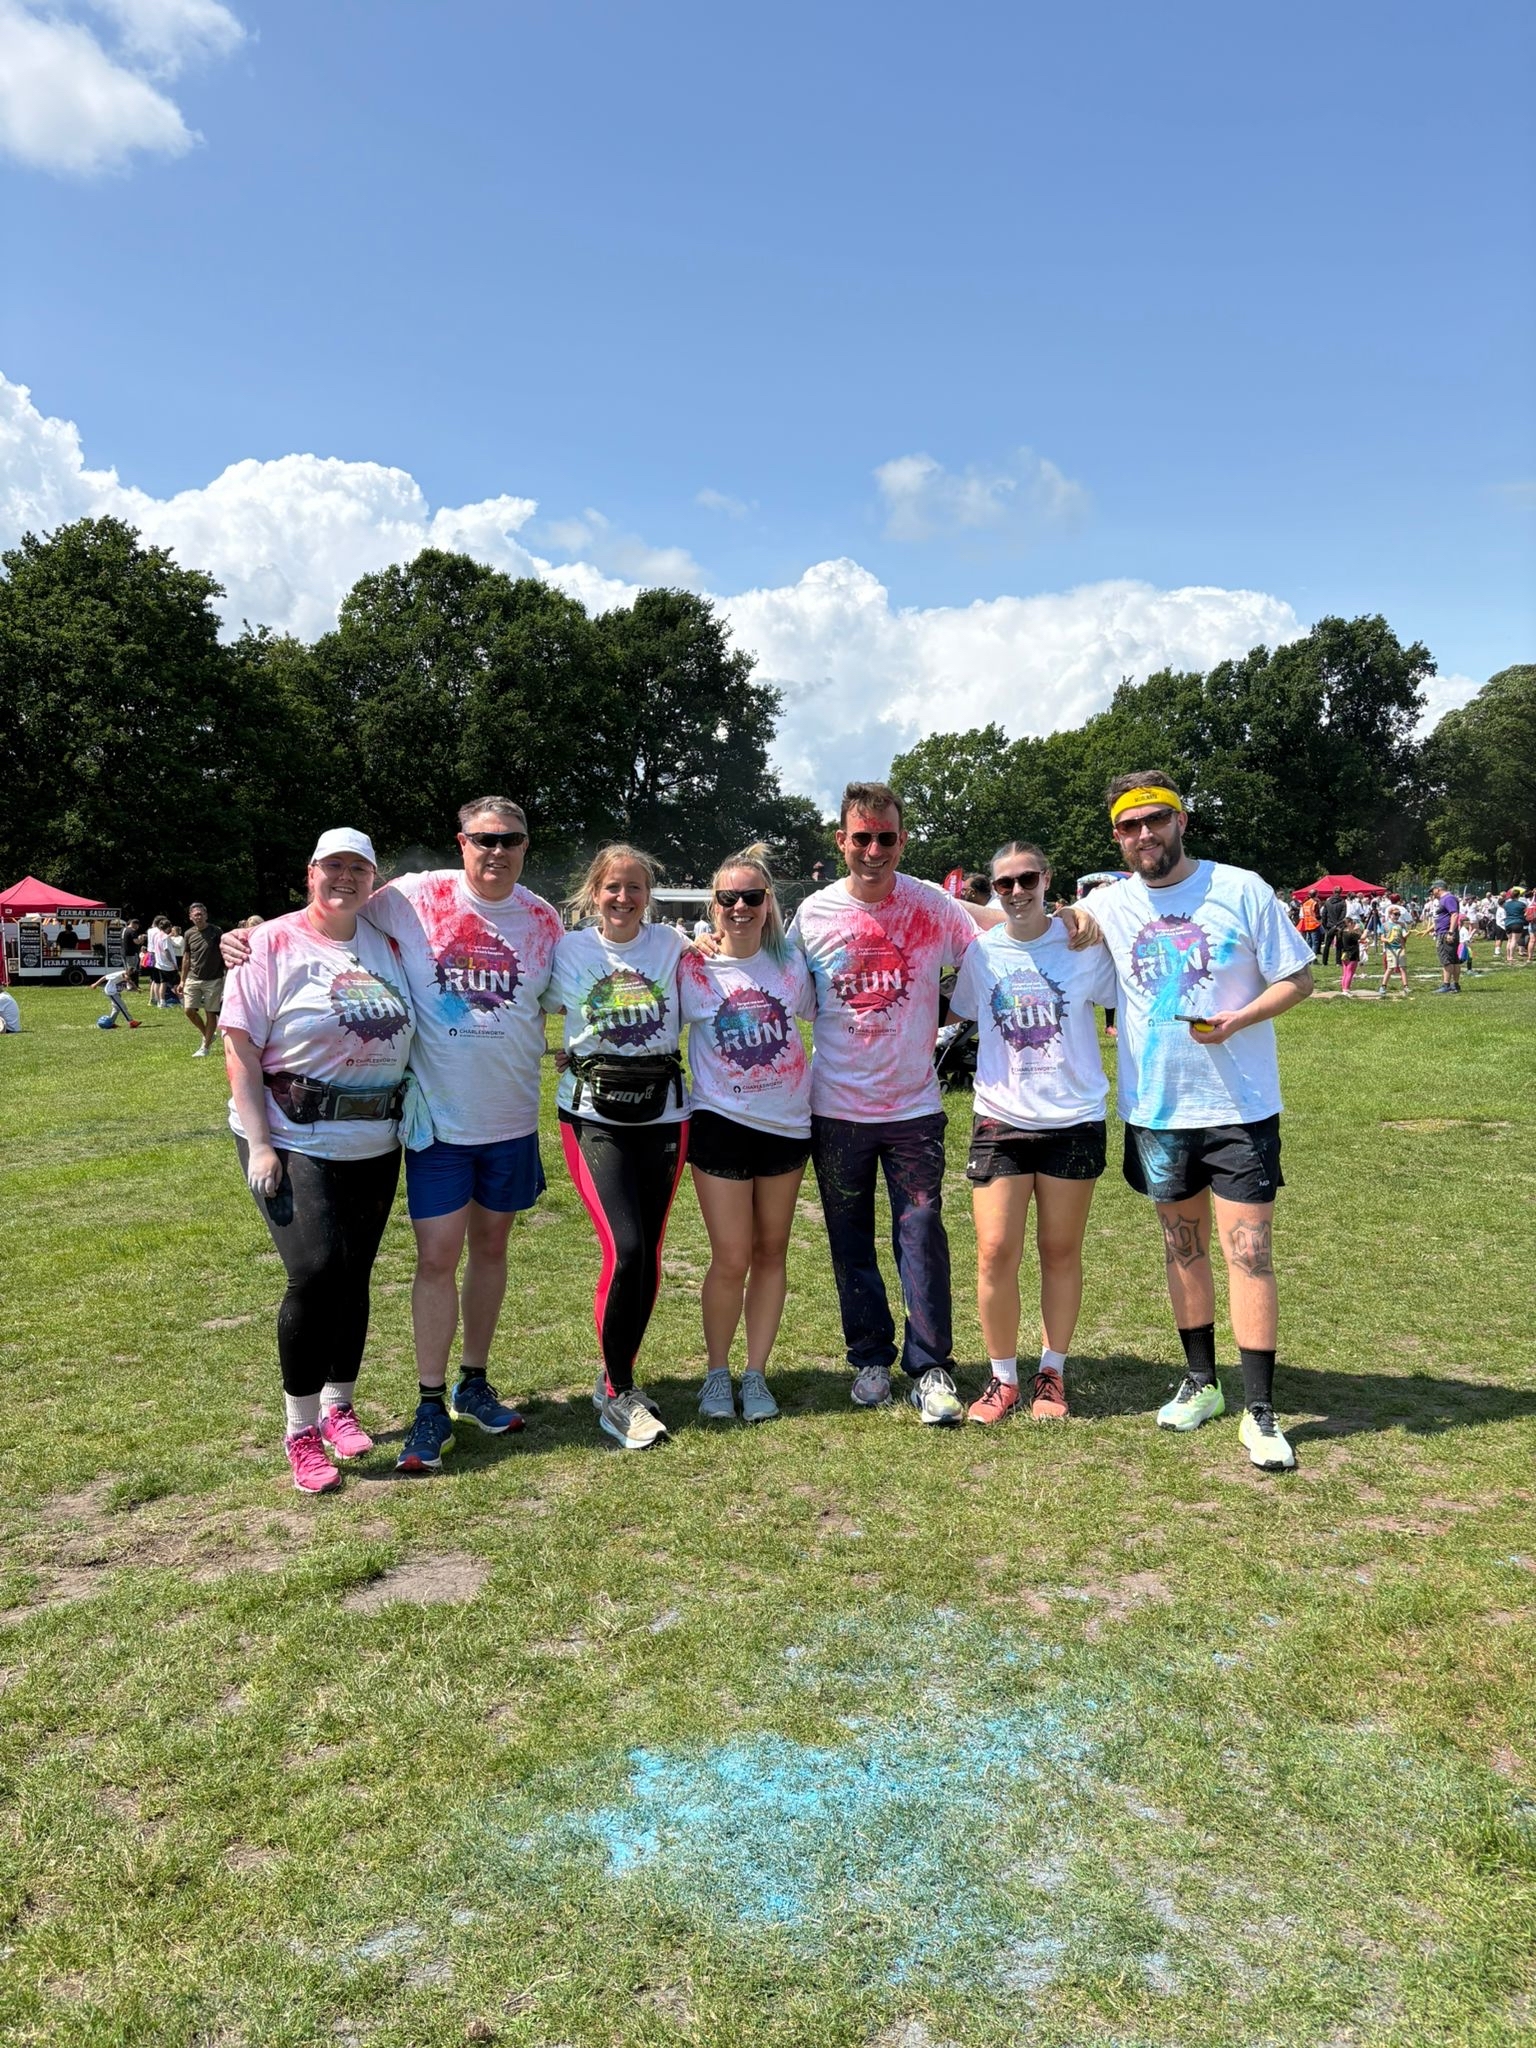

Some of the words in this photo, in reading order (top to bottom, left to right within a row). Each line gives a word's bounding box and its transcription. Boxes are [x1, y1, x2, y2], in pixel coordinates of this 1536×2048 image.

[89, 909, 117, 917] SAUSAGE
[444, 954, 510, 969] COLOUR
[1137, 947, 1203, 982] RUN
[444, 968, 510, 992] RUN
[839, 967, 902, 995] RUN
[340, 997, 406, 1022] RUN
[592, 1000, 660, 1031] RUN
[997, 1002, 1058, 1032] RUN
[722, 1018, 784, 1053] RUN
